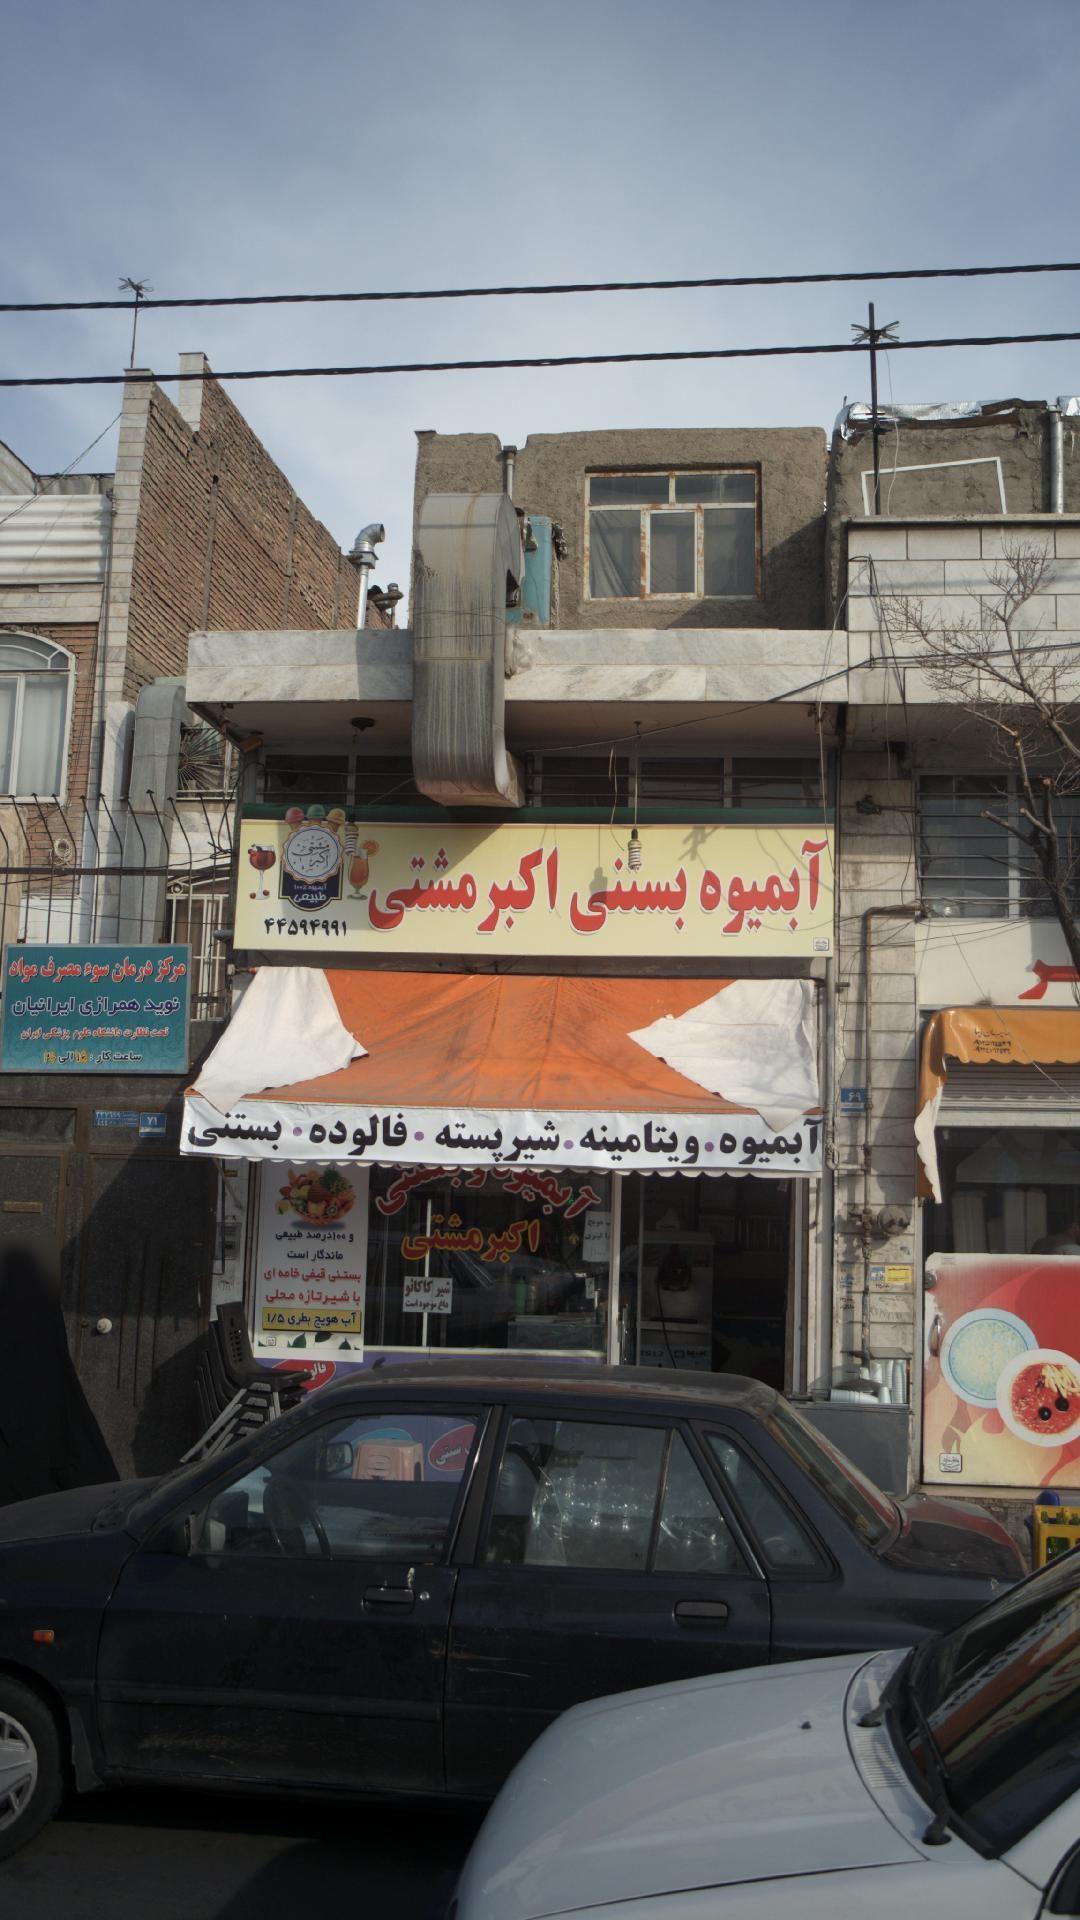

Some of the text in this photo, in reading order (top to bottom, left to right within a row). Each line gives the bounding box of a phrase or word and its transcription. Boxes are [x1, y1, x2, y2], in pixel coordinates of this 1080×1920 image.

[368, 839, 828, 934] آبمیوه بستنی اکبر مشتی
[264, 918, 347, 936] ۴۴۵۹۴۹۹۱
[9, 956, 187, 983] مرکز درمان سوء مصرف مواد
[12, 996, 181, 1016] نوید همرازی ایرانیان
[92, 1027, 122, 1037] دانشگاه
[96, 1051, 112, 1064] کار
[113, 1051, 142, 1061] ساعت
[188, 1112, 282, 1151] بستنی
[309, 1113, 408, 1156] فالوده
[580, 1120, 700, 1164] ویتامینه
[718, 1118, 822, 1165] آبمیوه
[275, 1230, 303, 1240] طبیعی
[401, 1212, 541, 1263] اکبر مشتی
[287, 1249, 344, 1261] ماندگار است
[302, 1267, 327, 1281] قیفی
[328, 1270, 362, 1283] بستنی
[265, 1288, 296, 1302] محلی
[352, 1290, 361, 1306] با
[314, 1314, 339, 1329] هویج
[341, 1311, 356, 1327] آب
